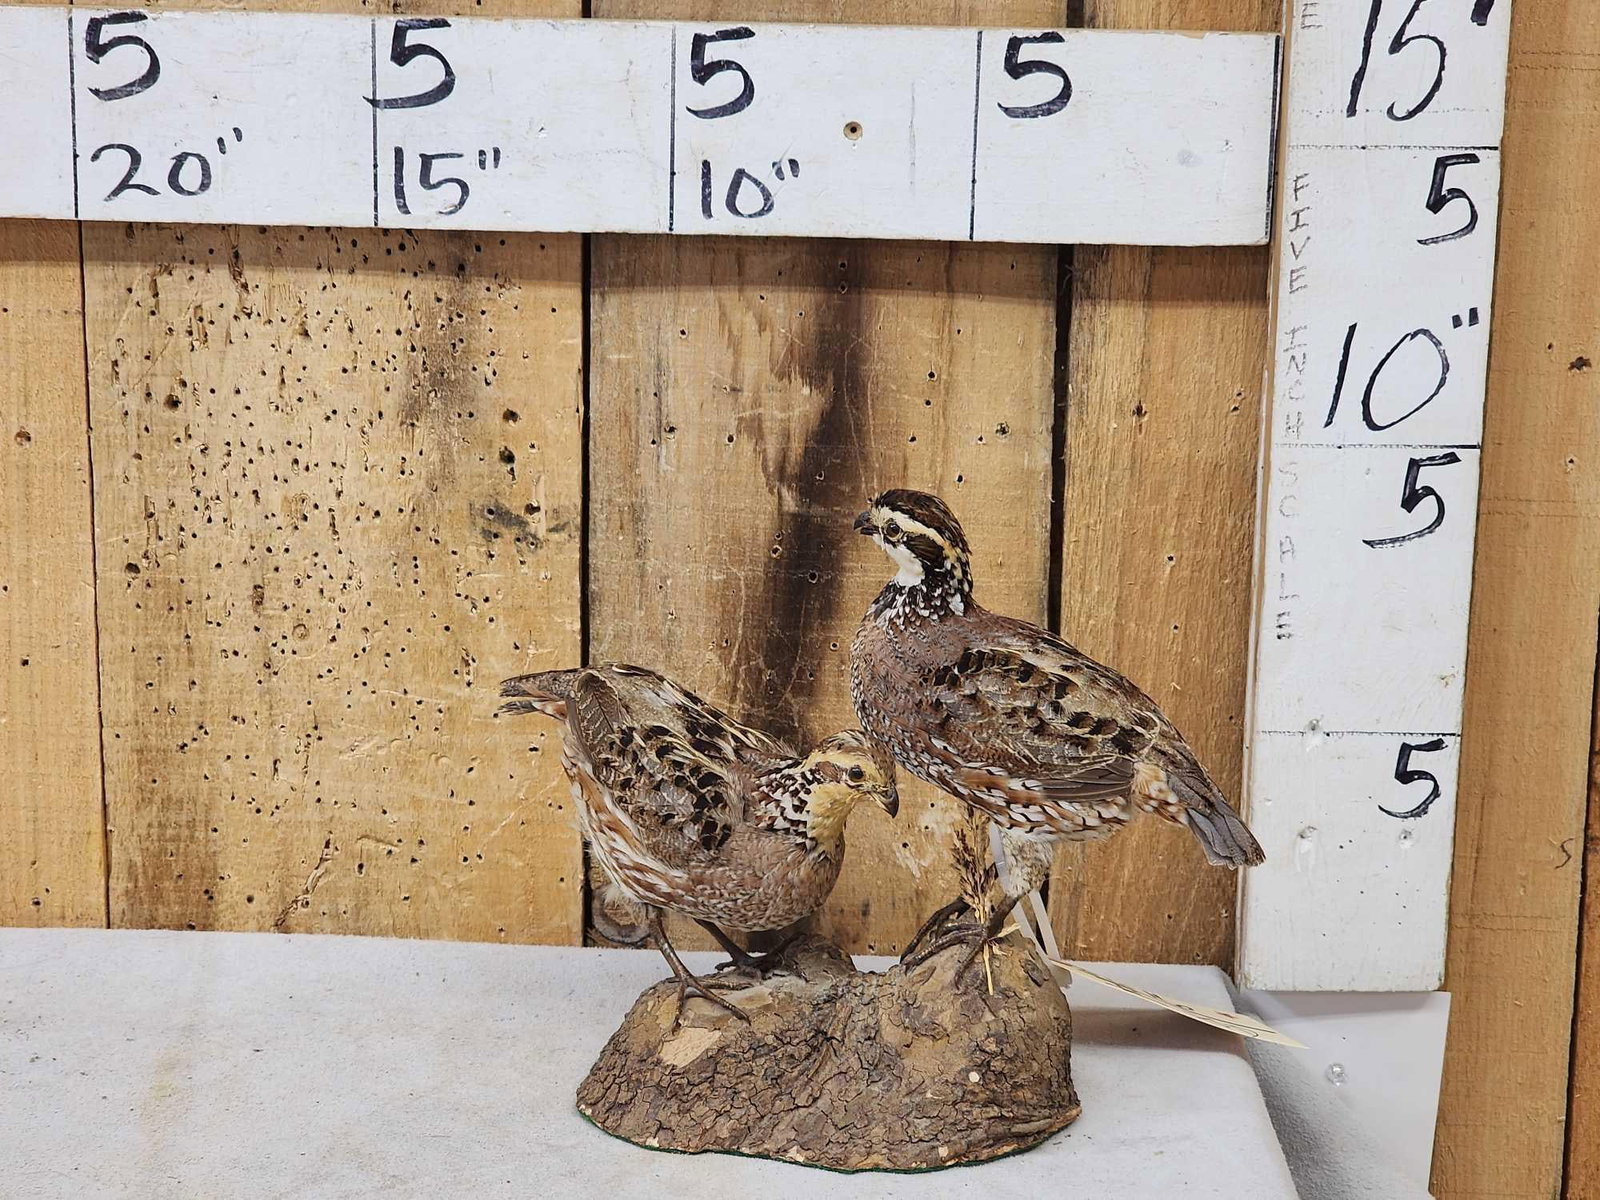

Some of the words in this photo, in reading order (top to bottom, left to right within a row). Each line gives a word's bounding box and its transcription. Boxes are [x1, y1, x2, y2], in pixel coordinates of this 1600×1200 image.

[85, 11, 161, 101] 5
[363, 18, 456, 109] 5
[685, 26, 755, 119] 5
[996, 31, 1072, 119] 5
[1287, 172, 1312, 295] FIVE
[1416, 153, 1481, 245] 5
[1362, 451, 1463, 550] 5
[1377, 737, 1449, 820] 5
